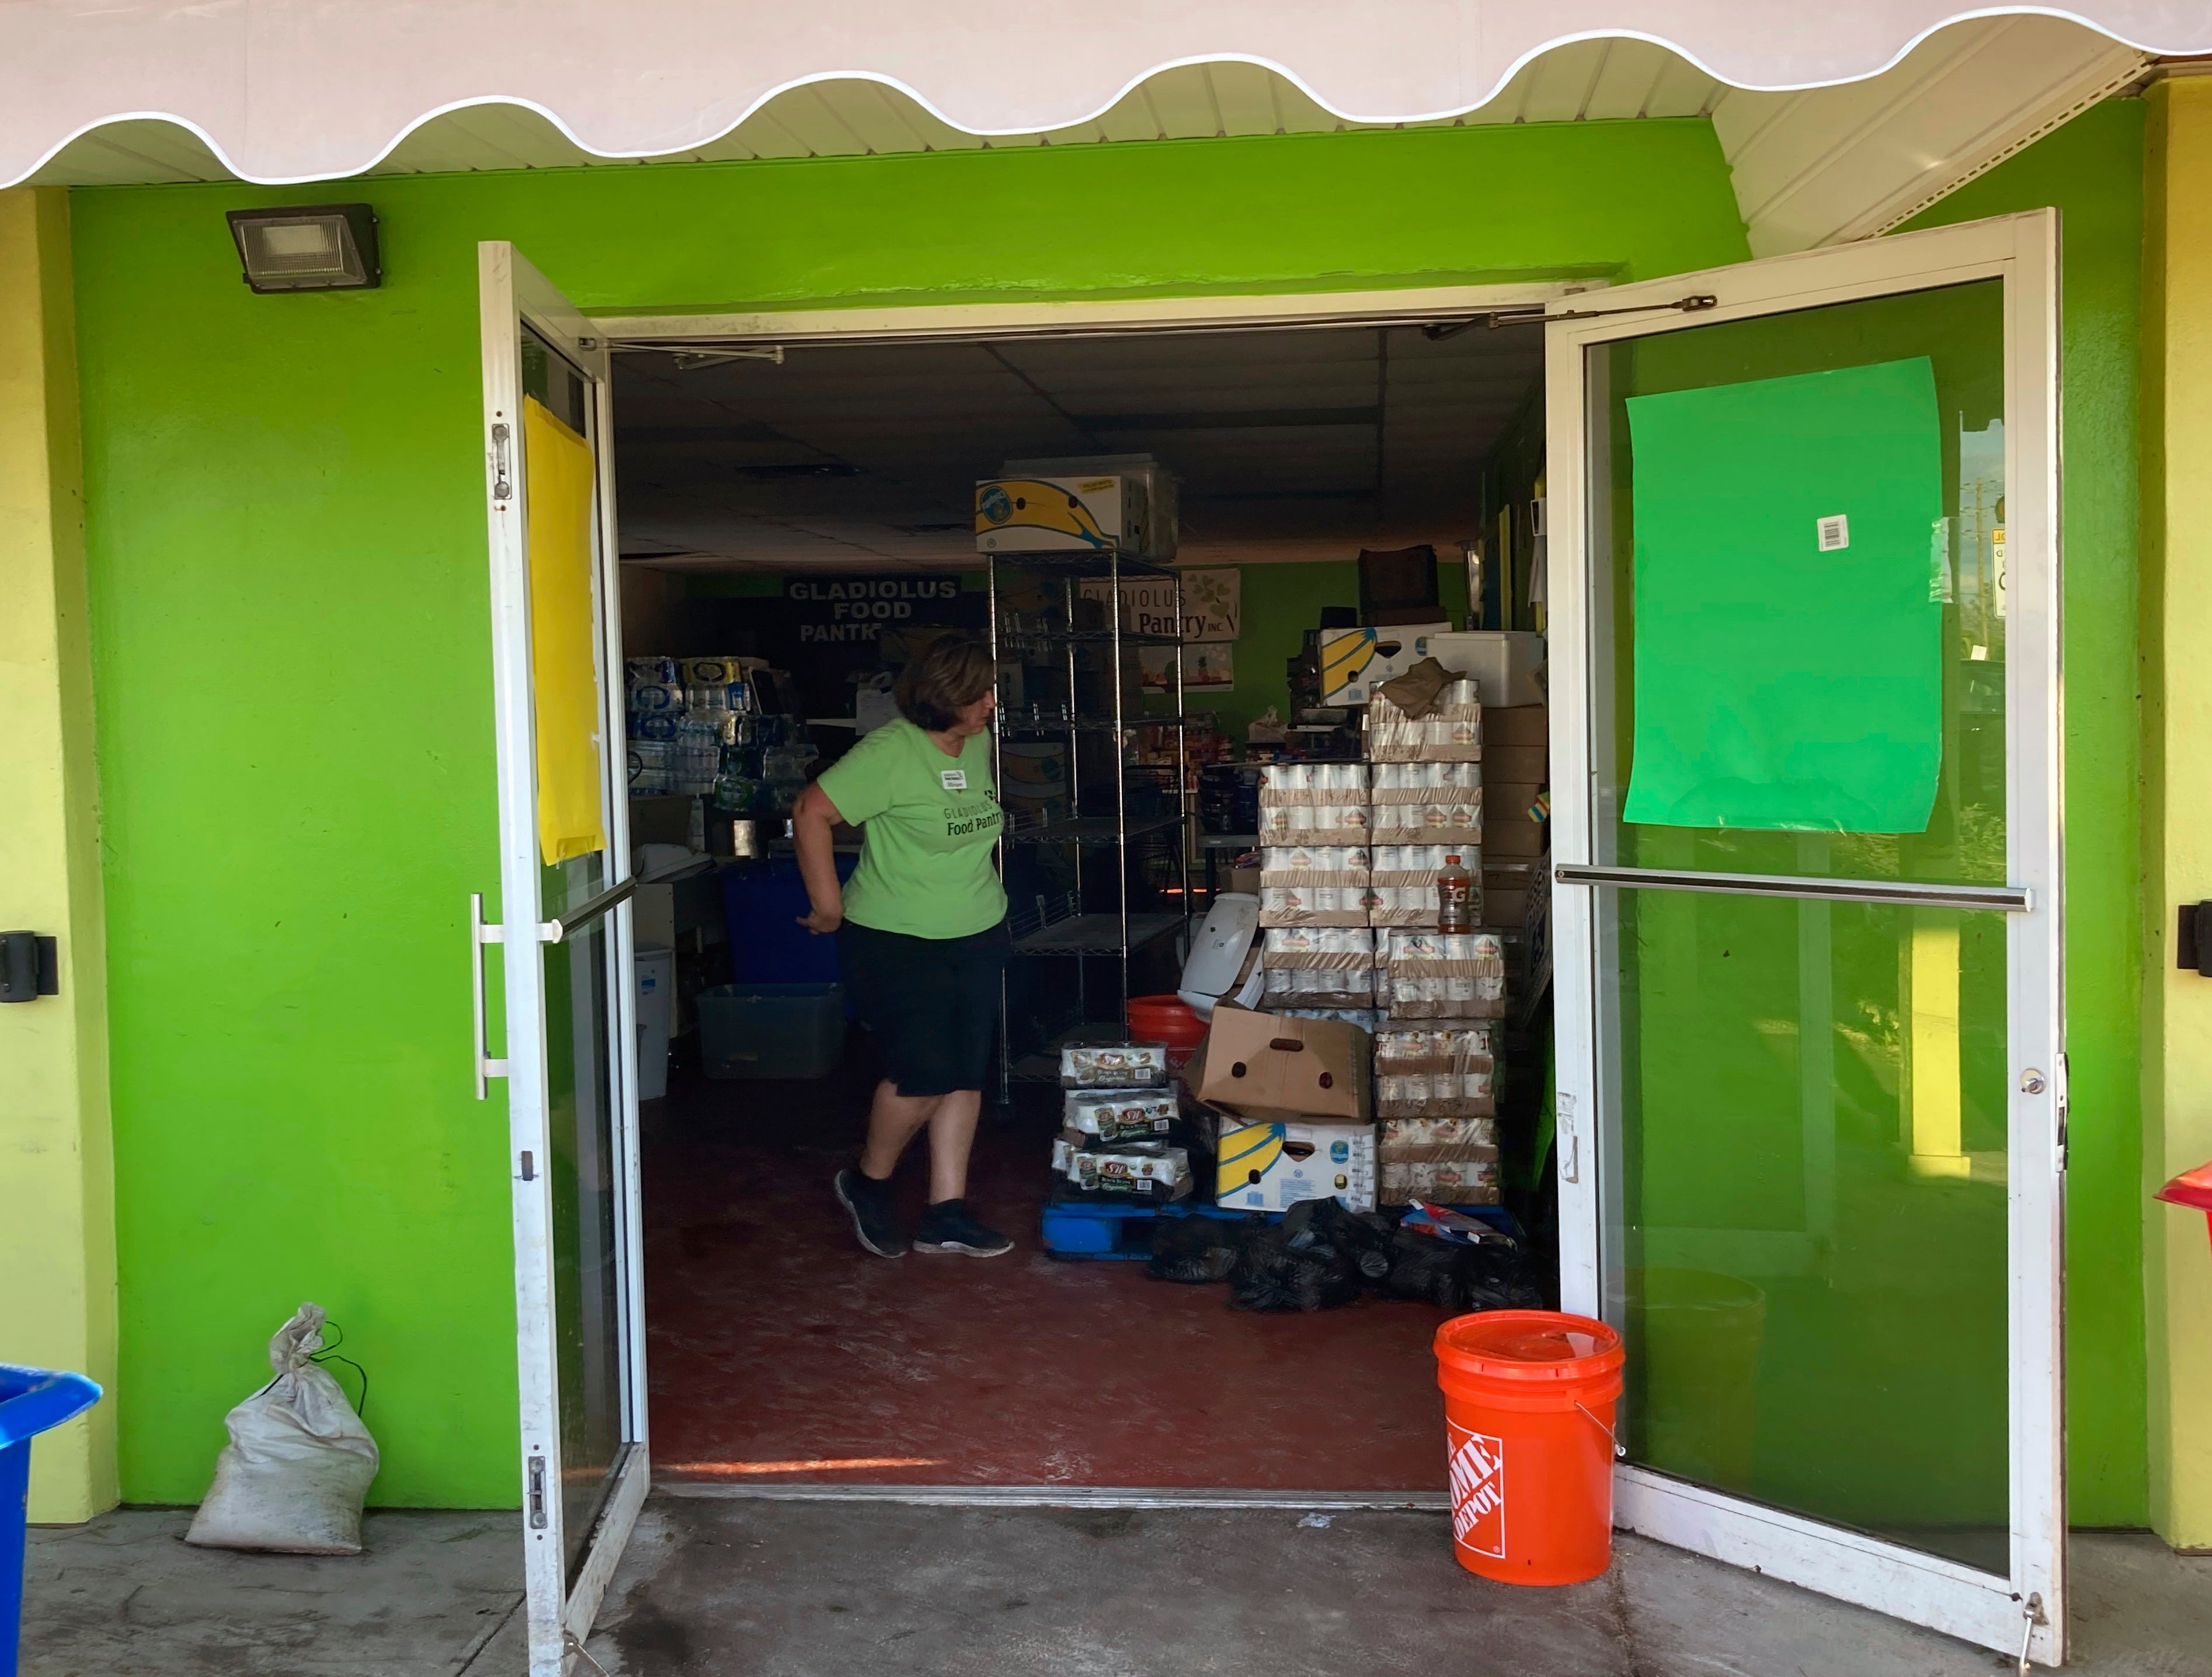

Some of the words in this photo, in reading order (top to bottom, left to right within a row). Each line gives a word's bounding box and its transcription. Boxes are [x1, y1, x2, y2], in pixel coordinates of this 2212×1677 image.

[789, 581, 956, 600] GLADIOLUS
[833, 601, 912, 619] FOOD
[1139, 613, 1206, 638] Panry
[944, 800, 992, 819] GLADIOLUS
[947, 819, 973, 836] Food
[1452, 887, 1466, 902] G
[1449, 1435, 1501, 1509] OME
